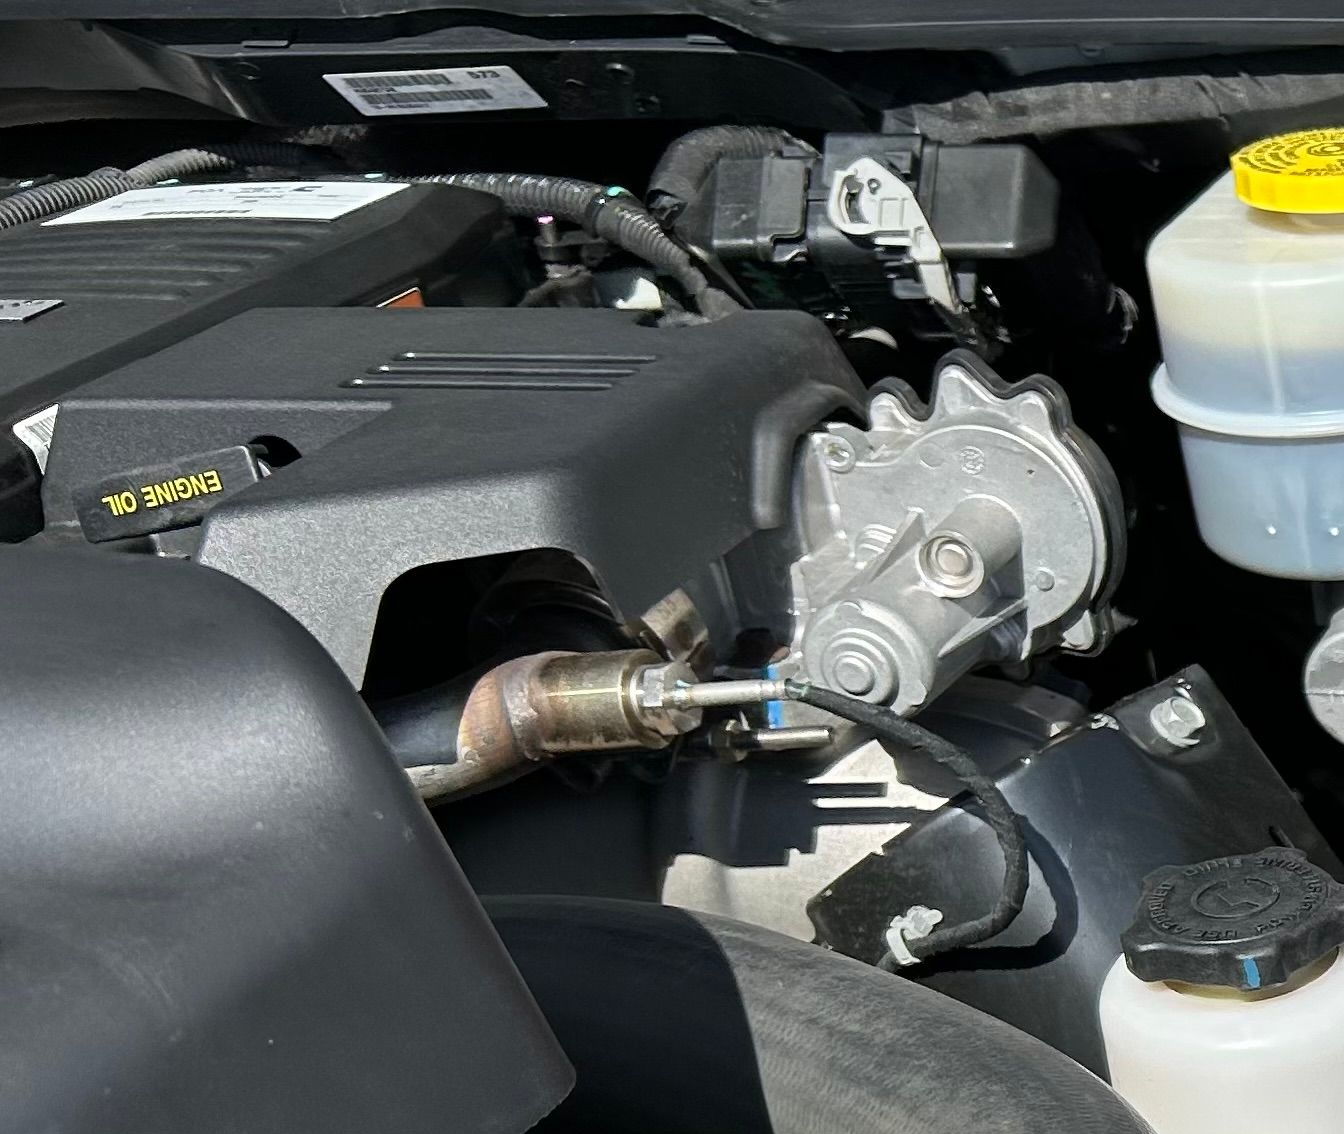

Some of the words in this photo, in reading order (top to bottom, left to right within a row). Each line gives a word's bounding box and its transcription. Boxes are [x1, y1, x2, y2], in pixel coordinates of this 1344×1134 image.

[467, 70, 500, 79] 573
[140, 470, 223, 508] ENGINE
[102, 491, 138, 516] OIL
